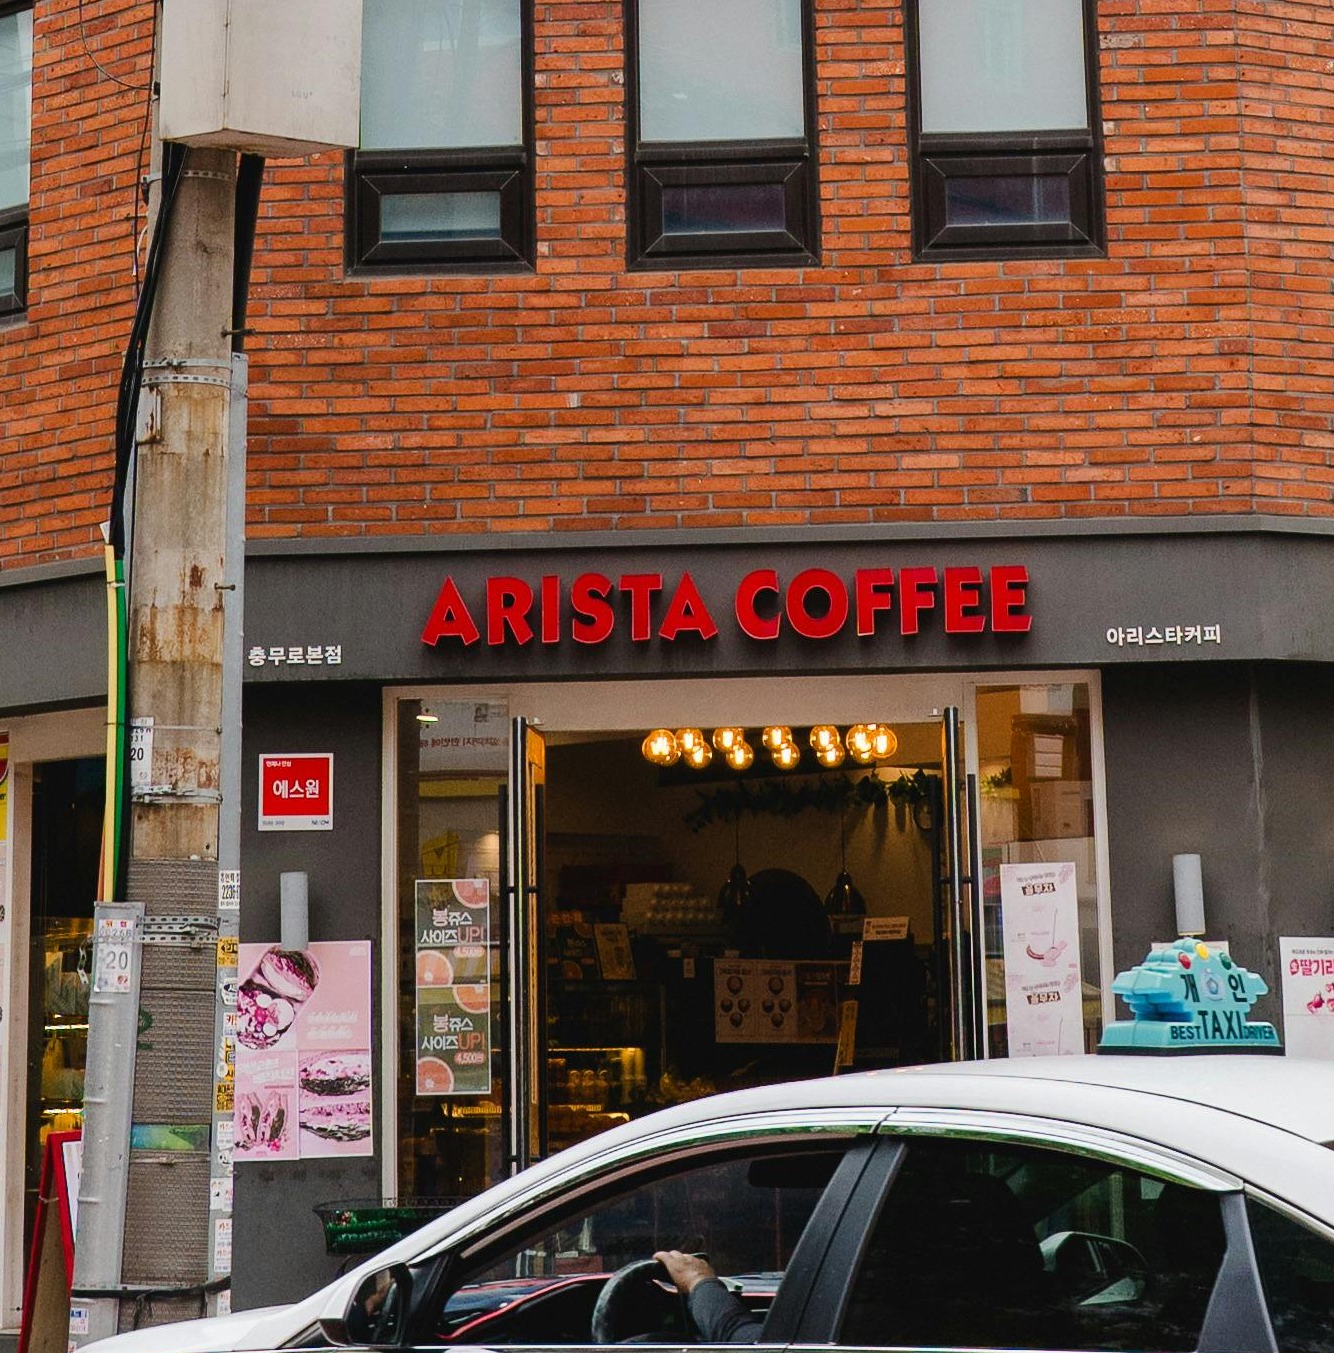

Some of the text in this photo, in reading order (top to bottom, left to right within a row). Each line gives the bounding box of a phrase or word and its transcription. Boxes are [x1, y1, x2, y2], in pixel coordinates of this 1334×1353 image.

[420, 564, 1033, 646] ARISTA COFFEE
[1106, 624, 1221, 647] 아리스타커피
[248, 645, 343, 666] 충무로본점
[273, 779, 320, 799] 에스원
[105, 951, 128, 970] 20
[1171, 1011, 1274, 1041] BEST TAXI DRIVER
